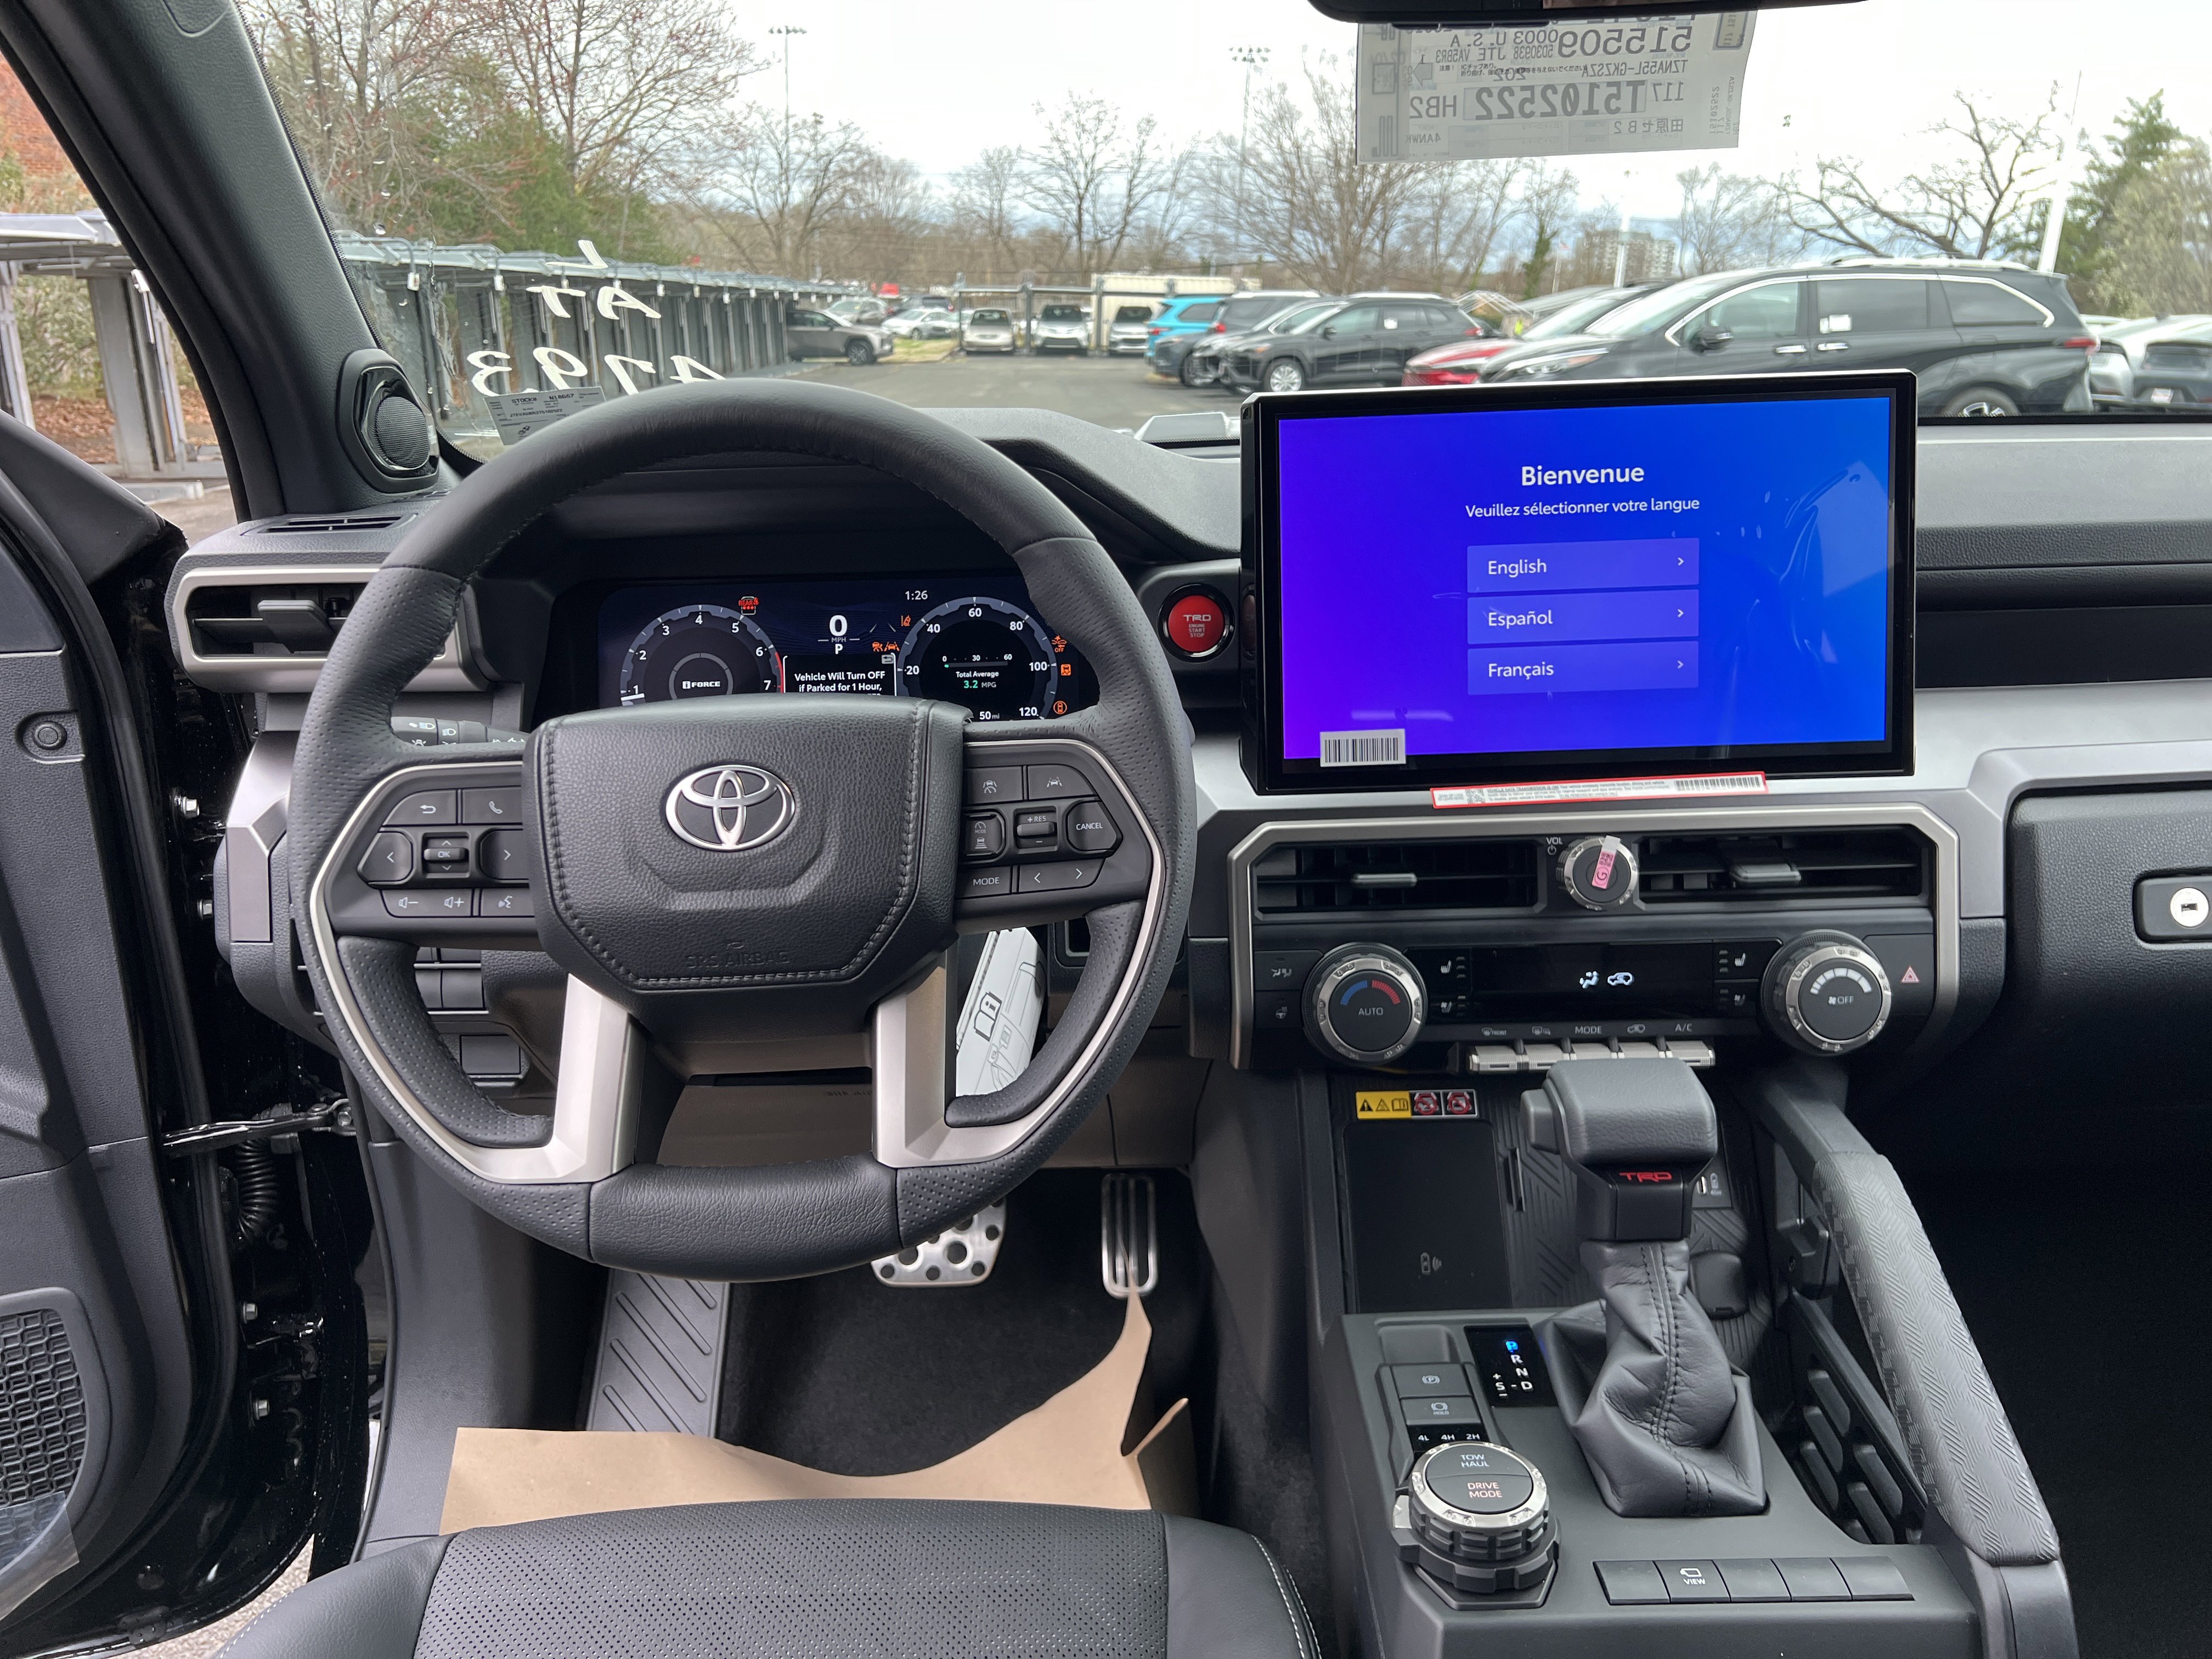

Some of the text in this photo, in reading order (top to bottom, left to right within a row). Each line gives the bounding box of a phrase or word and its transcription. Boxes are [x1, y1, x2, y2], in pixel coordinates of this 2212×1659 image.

[1521, 465, 1645, 486] Bienvenue
[1465, 498, 1700, 517] Veuillez sélectionner votre langue
[1488, 558, 1547, 578] English
[905, 590, 928, 600] 1:26
[968, 608, 981, 617] 60
[695, 614, 703, 624] 4
[1488, 610, 1553, 629] Español
[662, 625, 670, 635] 3
[732, 623, 739, 633] 5
[829, 615, 848, 636] 0
[927, 624, 940, 633] 40
[1009, 621, 1023, 630] 80
[755, 646, 763, 657] 6
[835, 644, 843, 654] P
[639, 650, 647, 660] 2
[906, 665, 919, 675] 20
[1029, 662, 1047, 672] 100
[1488, 661, 1554, 680] Français
[794, 671, 885, 681] Vehicle Will Turn OFF
[973, 670, 999, 678] Average
[633, 685, 639, 694] 1
[764, 680, 771, 690] 7
[799, 684, 805, 692] if
[807, 684, 836, 692] Parked
[838, 683, 848, 691] for
[858, 682, 882, 692] Hour,
[963, 680, 979, 689] 3.2
[1019, 707, 1037, 716] 120
[1076, 822, 1103, 831] CANCEL
[973, 877, 1000, 886] MODE
[1837, 996, 1854, 1005] OFF
[1358, 1007, 1384, 1016] AUTO
[1575, 1025, 1602, 1035] MODE
[1675, 1023, 1692, 1032] A/C
[1620, 1171, 1672, 1182] TRD
[1506, 1340, 1519, 1353] P
[1510, 1354, 1523, 1364] R
[1515, 1367, 1528, 1378] N
[1496, 1381, 1533, 1391] S D
[1469, 1490, 1502, 1498] MODE
